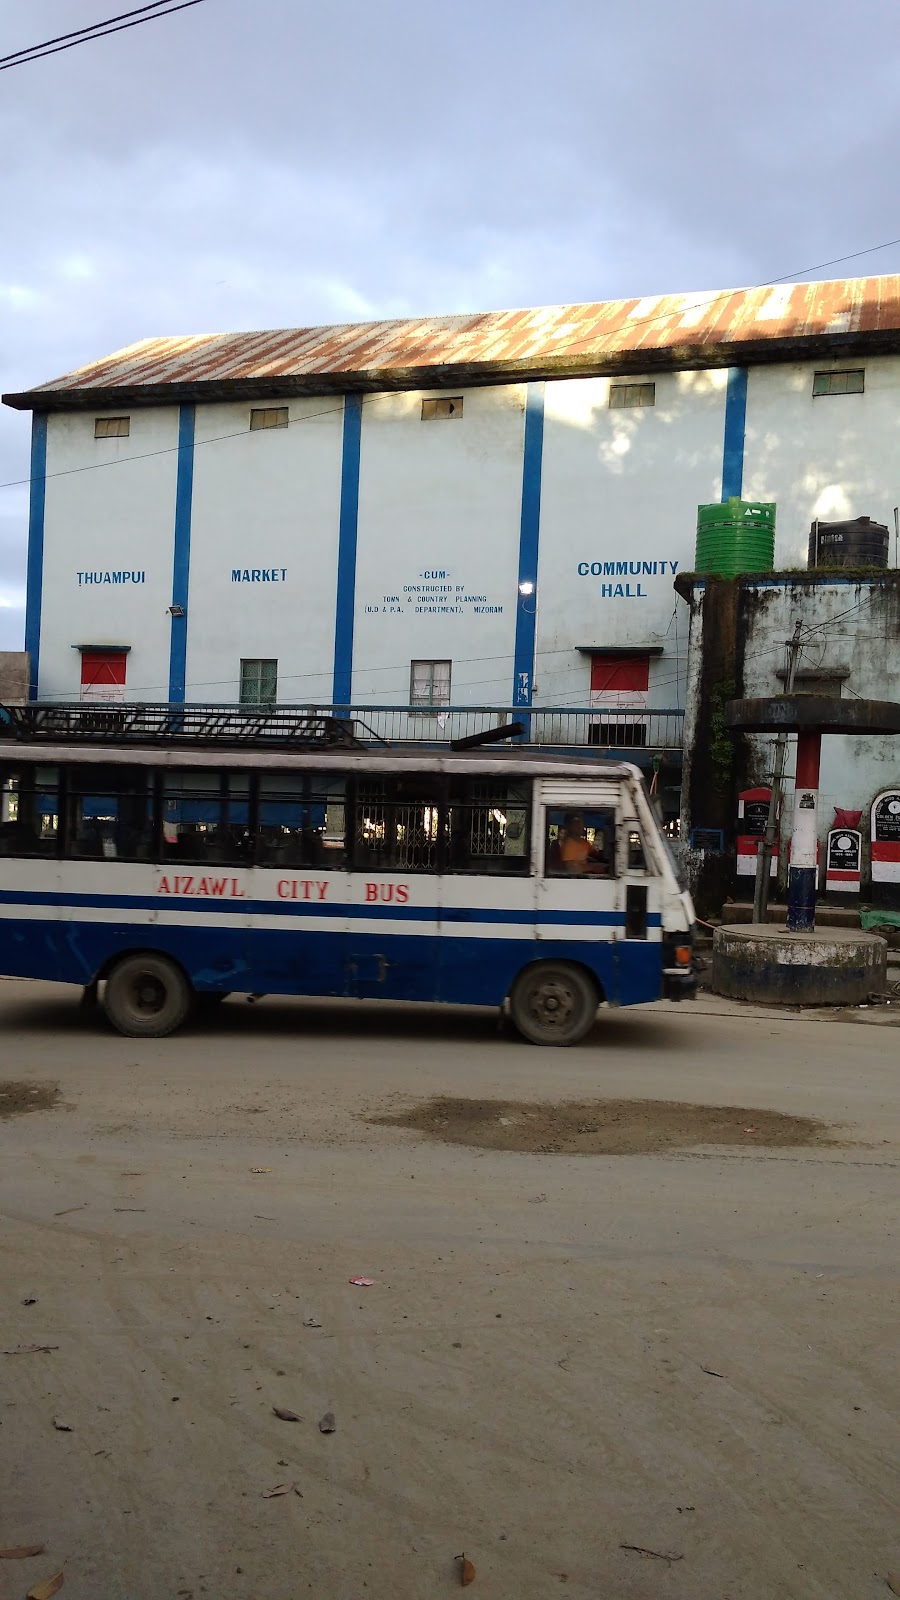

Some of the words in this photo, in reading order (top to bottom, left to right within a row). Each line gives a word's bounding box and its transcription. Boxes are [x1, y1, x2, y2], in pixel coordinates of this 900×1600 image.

[577, 561, 679, 576] COMMUNITY
[231, 569, 288, 582] MARKET
[403, 585, 452, 593] CONSTRUCTED
[455, 585, 465, 593] BY
[601, 584, 648, 598] HALL
[383, 595, 400, 603] TOWN
[417, 595, 448, 603] COUNTRY
[455, 595, 487, 603] PLANNING
[473, 606, 503, 614] MIZORAM
[157, 876, 246, 898] AIZAWL
[277, 879, 329, 900] CITY
[364, 883, 409, 904] BUS
